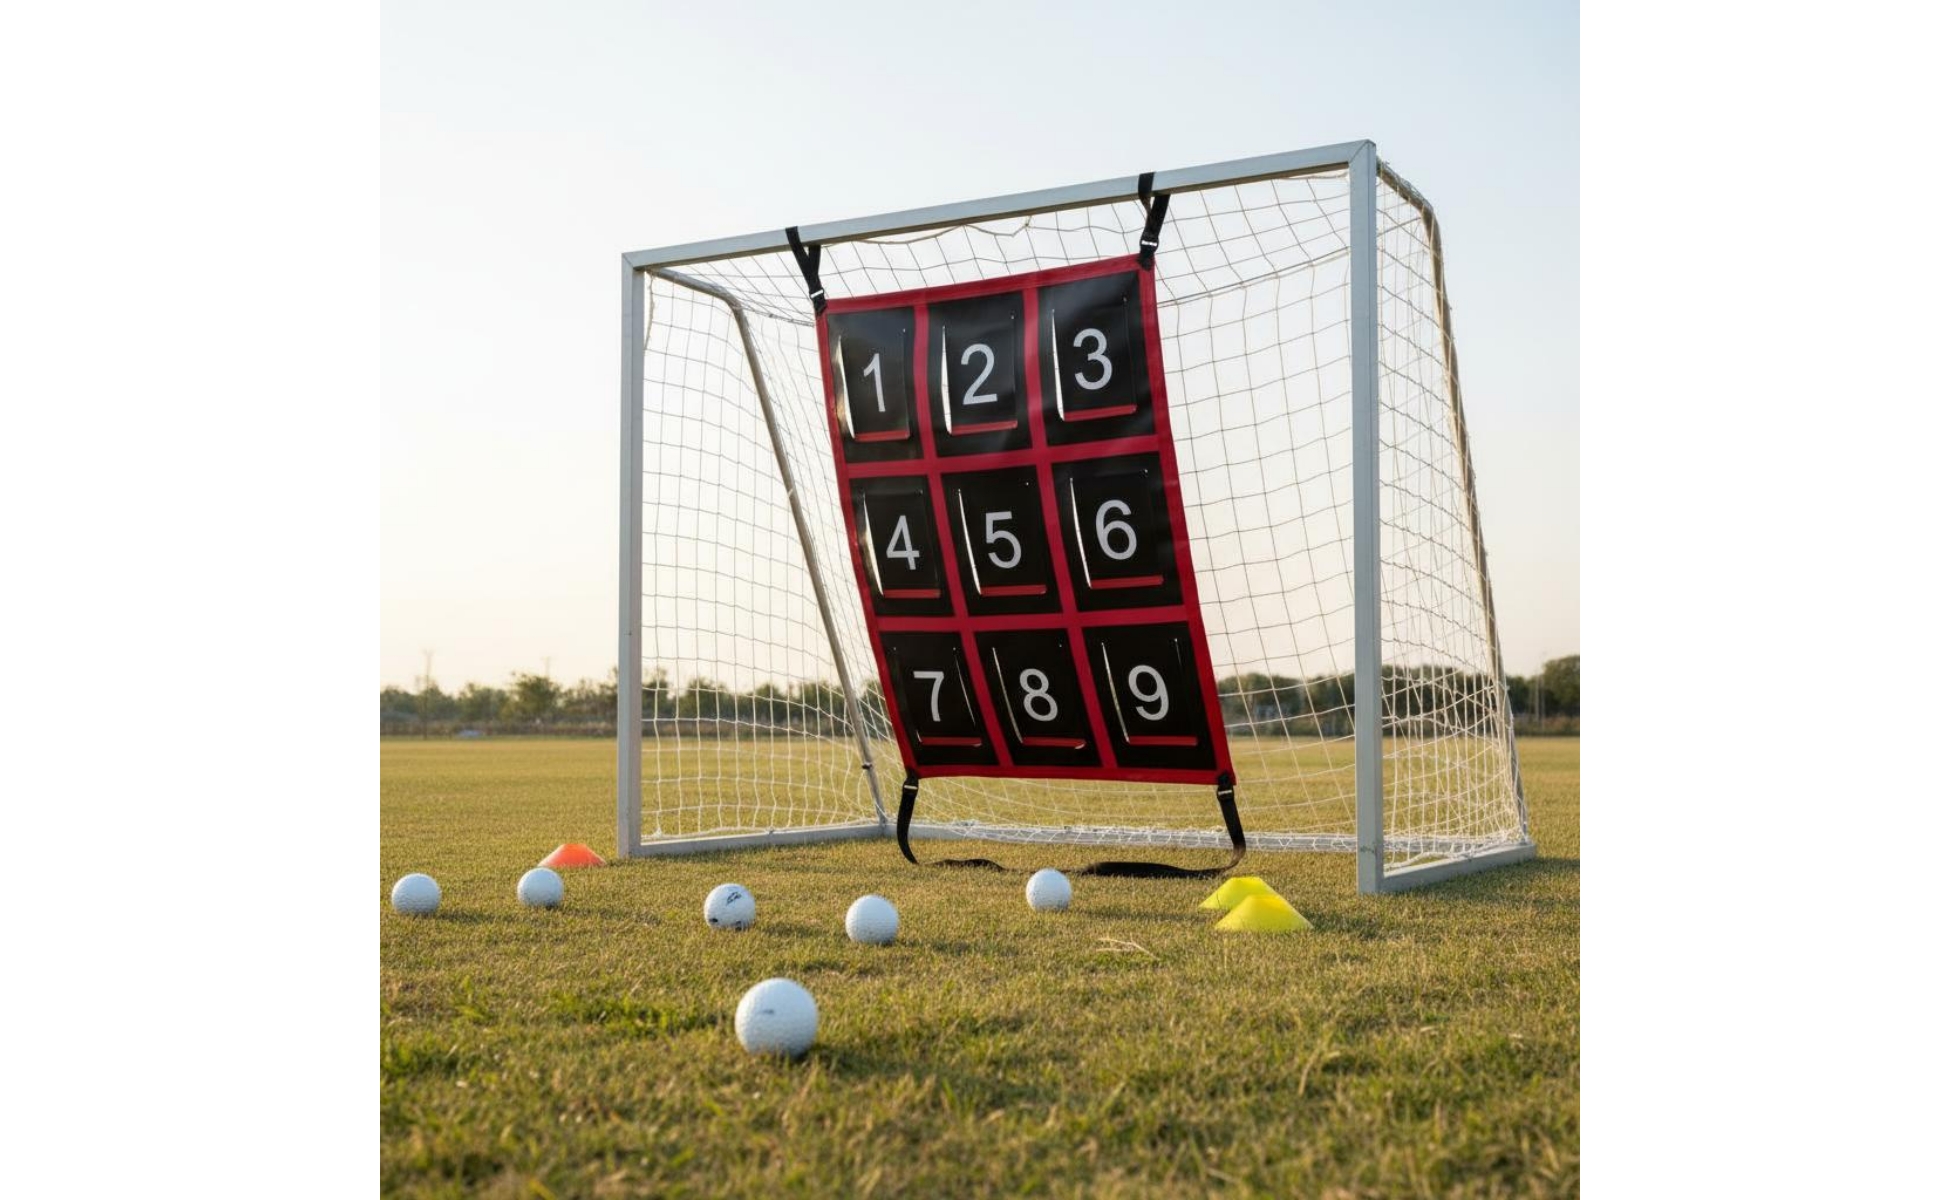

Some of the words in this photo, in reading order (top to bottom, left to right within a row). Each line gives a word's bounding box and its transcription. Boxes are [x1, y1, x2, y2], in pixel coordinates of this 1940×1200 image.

[863, 353, 886, 412] 1
[960, 343, 998, 405] 2
[1073, 328, 1112, 390] 3
[886, 515, 920, 570] 4
[985, 511, 1022, 569] 5
[1095, 500, 1137, 560] 6
[914, 671, 944, 722] 7
[1019, 668, 1058, 721] 8
[1128, 665, 1169, 720] 9
